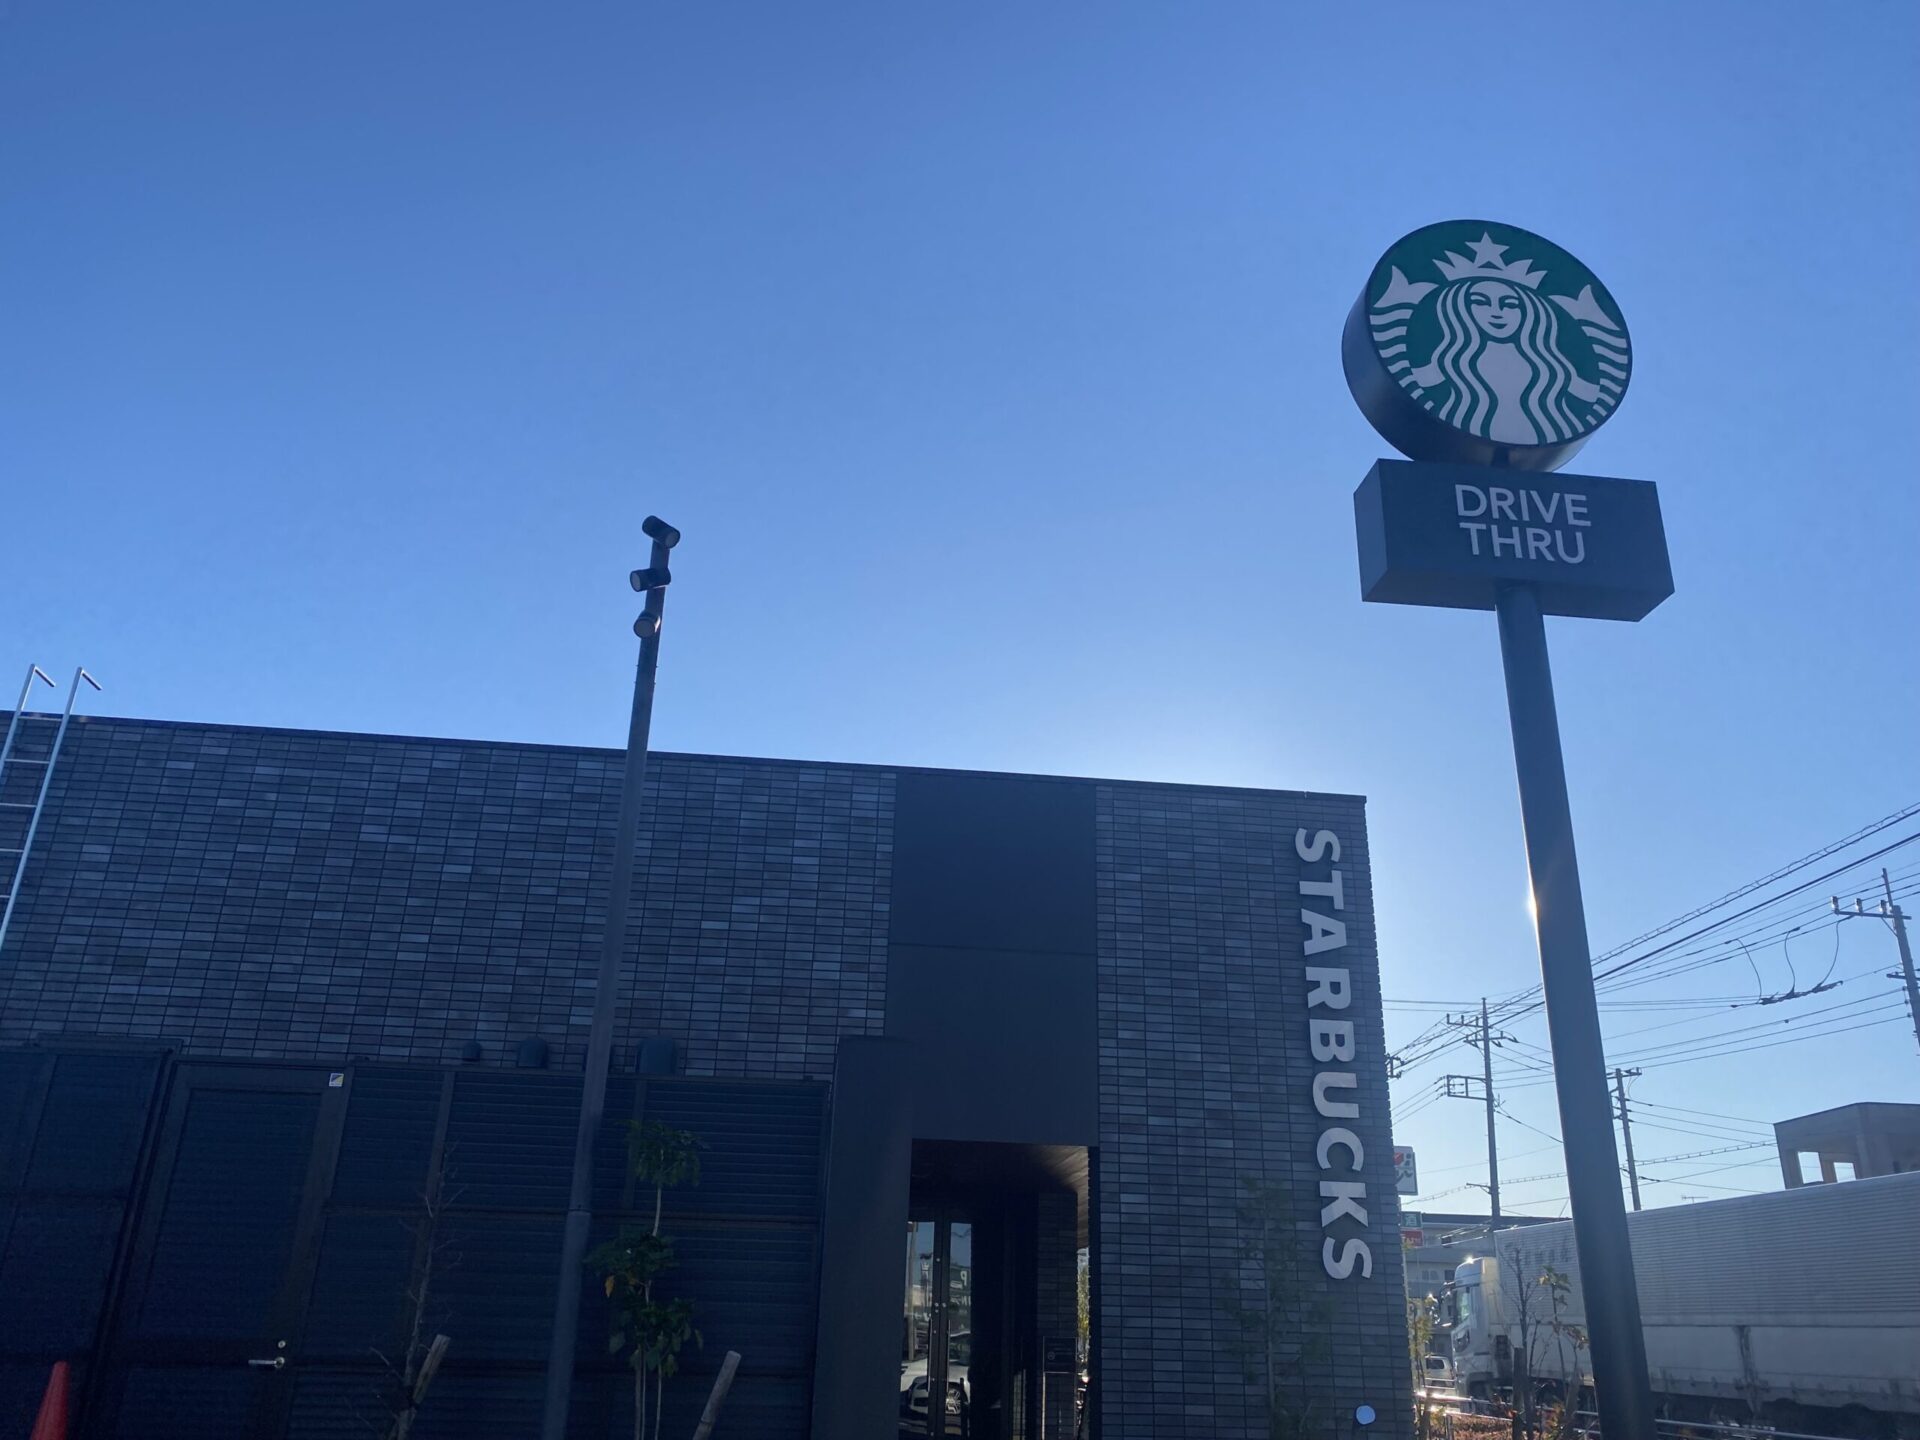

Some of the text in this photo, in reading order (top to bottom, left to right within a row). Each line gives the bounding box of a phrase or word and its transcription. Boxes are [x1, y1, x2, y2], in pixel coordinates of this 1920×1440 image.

[1455, 484, 1592, 527] DRIVE
[1459, 522, 1586, 564] THRU
[1295, 828, 1373, 1279] STARBUCKS
